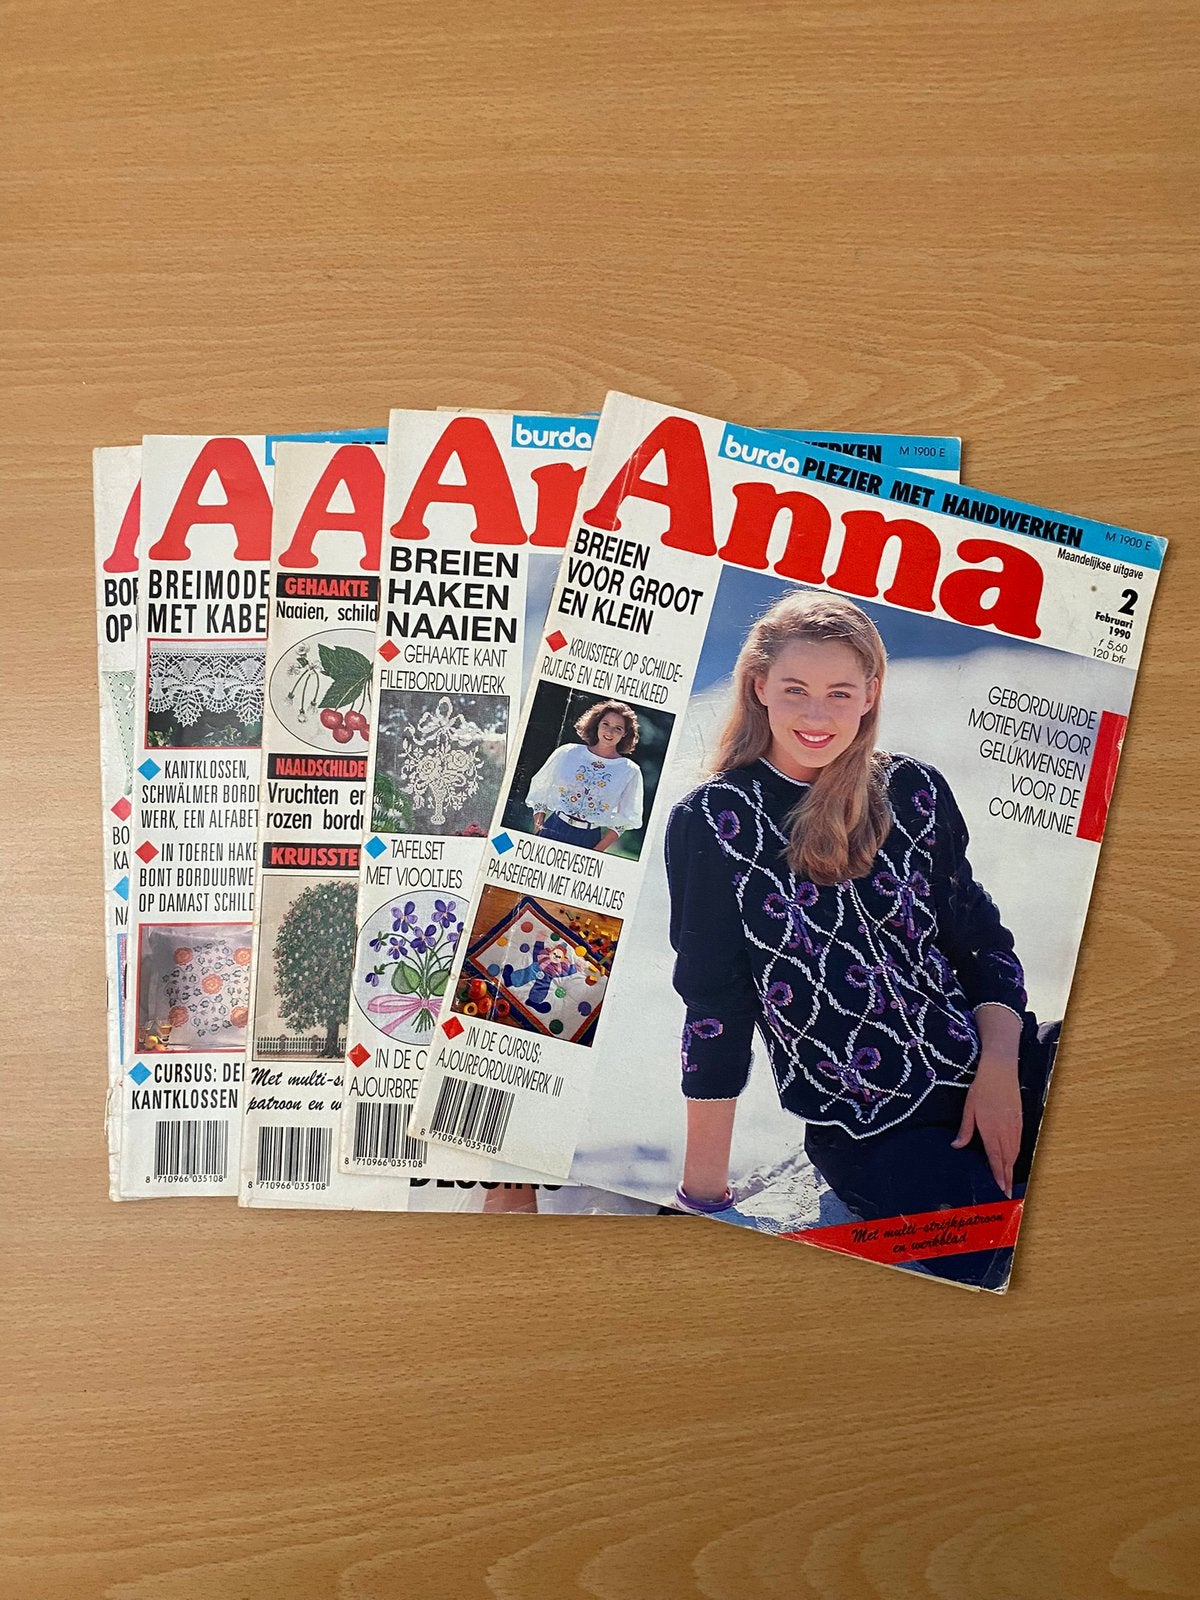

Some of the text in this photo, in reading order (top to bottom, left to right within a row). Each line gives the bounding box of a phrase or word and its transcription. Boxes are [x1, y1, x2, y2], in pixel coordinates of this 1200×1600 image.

[515, 423, 592, 449] burda
[724, 434, 800, 475] burda
[899, 446, 945, 457] M 1900 E
[801, 457, 1083, 548] PLEZIER MET HANDWERKEN
[583, 415, 1044, 640] Anna
[573, 527, 650, 571] BREIEN
[1105, 531, 1152, 551] M 1900 E
[389, 546, 519, 578] BREIEN
[1057, 547, 1144, 580] Maandelijkse uitgave
[149, 569, 270, 600] BREIMODE
[284, 577, 369, 598] GEHAAKTE
[387, 578, 509, 611] HAKEN
[567, 557, 704, 615] VOOR GROOT
[276, 600, 328, 622] Naaien,
[557, 587, 654, 635] EN KLEIN
[1117, 588, 1139, 616] 2
[105, 613, 132, 643] OP
[147, 603, 197, 633] MET
[385, 610, 517, 643] NAAIEN
[1095, 611, 1133, 629] Februari
[1109, 626, 1131, 640] 1990
[404, 644, 507, 668] GEHAAKTE KANT
[568, 637, 683, 683] KRUISSTEEK OP SCHILDE-
[1092, 647, 1126, 664] 120 bfr
[379, 669, 505, 694] FILETBORDUURWERK
[541, 655, 669, 705] RIJTJES EN EEN TAFELKLEED
[988, 686, 1097, 730] GEBORDUURDE
[968, 708, 1091, 756] MOTIEVEN VOOR
[165, 760, 250, 780] KANTKLOSSEN,
[979, 739, 1086, 782] GELUKWENSEN
[141, 782, 218, 804] SCHWÄLMER
[267, 782, 338, 805] Vruchten
[1011, 773, 1081, 809] VOOR DE
[141, 809, 179, 830] WERK,
[183, 809, 205, 828] EEN
[266, 809, 363, 830] rozen bord
[988, 797, 1075, 835] COMMUNIE
[161, 843, 174, 862] IN
[178, 842, 224, 862] TOEREN
[270, 847, 359, 866] KRUISSTE
[391, 839, 445, 860] TAFELSET
[515, 839, 604, 879] FOLKLOREVESTEN
[139, 867, 173, 887] BONT
[365, 865, 463, 889] MET VIOOLTJES
[486, 858, 625, 911] PAASEIEREN MET KRAALTJES
[138, 893, 155, 912] OP
[159, 892, 210, 912] DAMAST
[465, 1025, 542, 1064] IN DE CURSUS:
[375, 1048, 389, 1069] IN
[394, 1049, 412, 1070] DE
[154, 1063, 217, 1083] CURSUS:
[251, 1066, 283, 1086] Met
[435, 1047, 564, 1097] AJOURBORDUURWERK III
[131, 1089, 238, 1110] KANTKLOSSEN
[245, 1096, 302, 1115] patroon
[308, 1099, 324, 1111] en
[431, 1131, 463, 1146] 710966
[465, 1140, 497, 1155] 035108
[356, 1157, 388, 1167] 710966
[390, 1159, 423, 1168] 035108
[157, 1175, 189, 1183] 710966
[192, 1174, 224, 1183] 035108
[259, 1181, 292, 1190] 710966
[294, 1182, 326, 1191] 035108
[852, 1228, 880, 1243] Met
[892, 1243, 906, 1253] en
